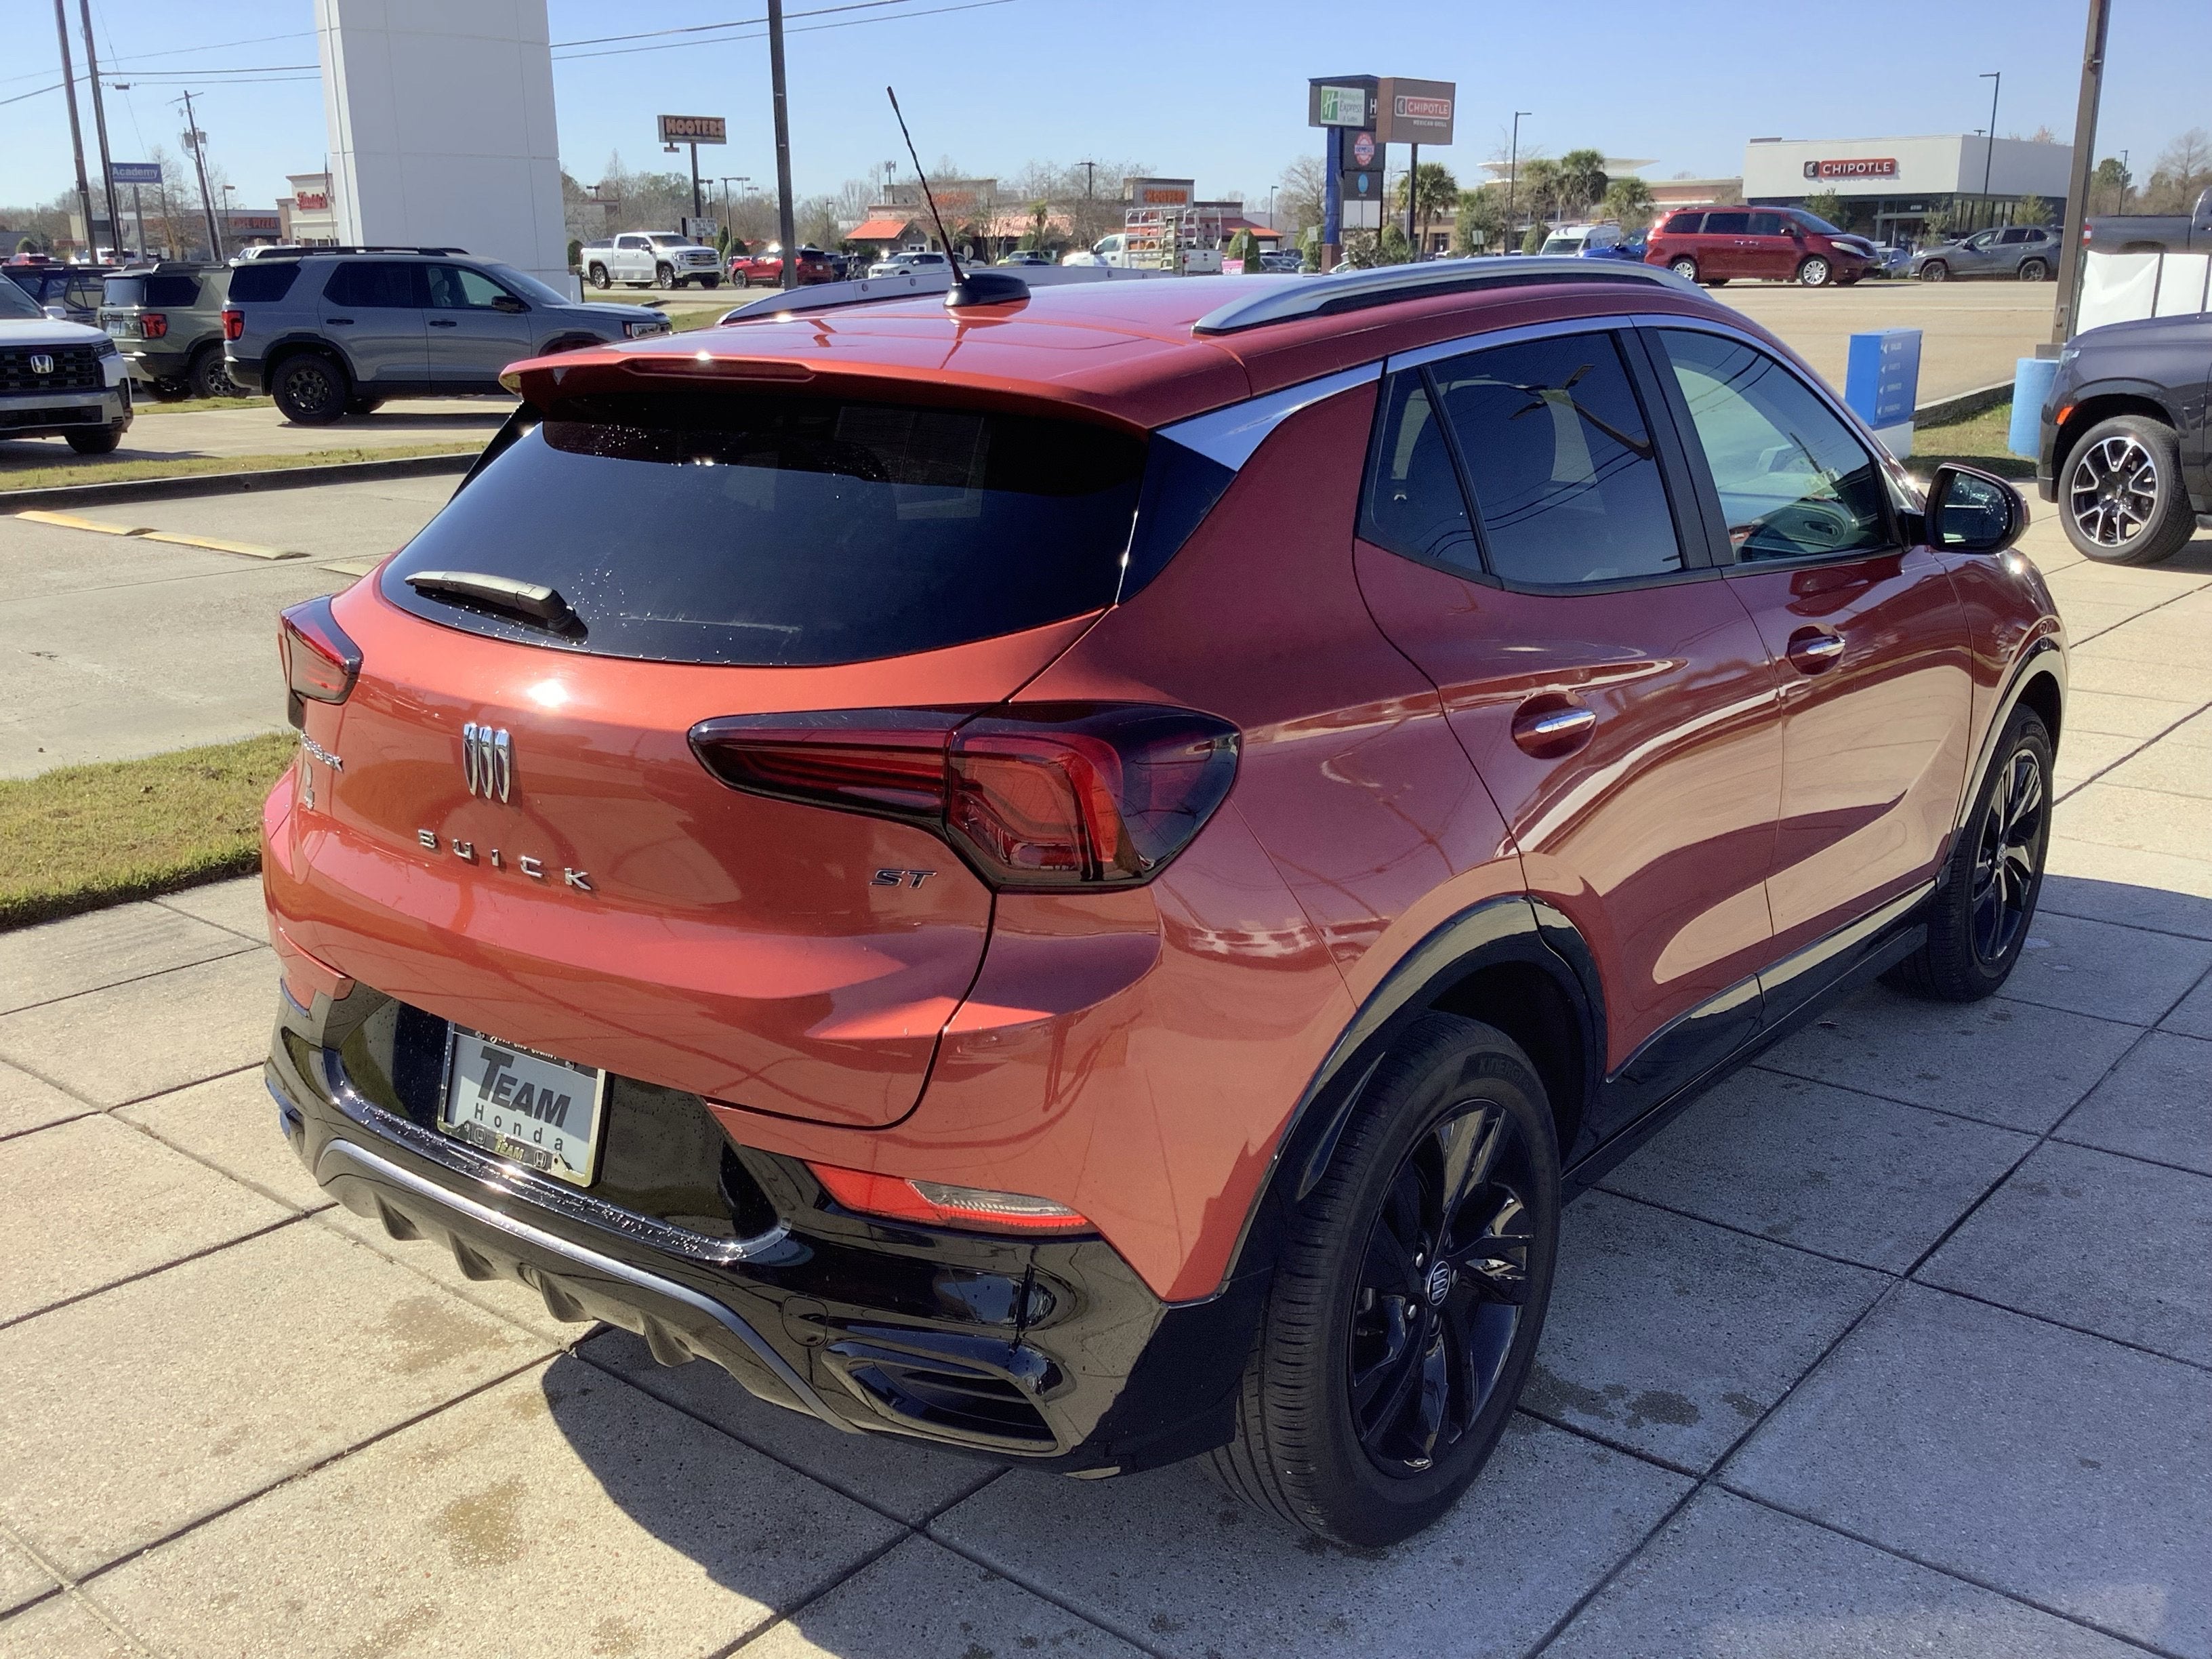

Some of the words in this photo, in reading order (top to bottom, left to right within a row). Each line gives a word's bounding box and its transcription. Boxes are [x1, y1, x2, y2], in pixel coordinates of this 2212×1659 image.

[1340, 100, 1362, 113] Express
[1408, 102, 1448, 115] CHIPOTLE
[665, 118, 724, 136] HOOTERS
[112, 167, 158, 179] Academy
[1822, 162, 1891, 174] CHIPOTLE
[417, 828, 592, 890] BUICK
[869, 868, 937, 888] ST
[478, 1046, 571, 1128] TEAM
[474, 1103, 563, 1151] Honda
